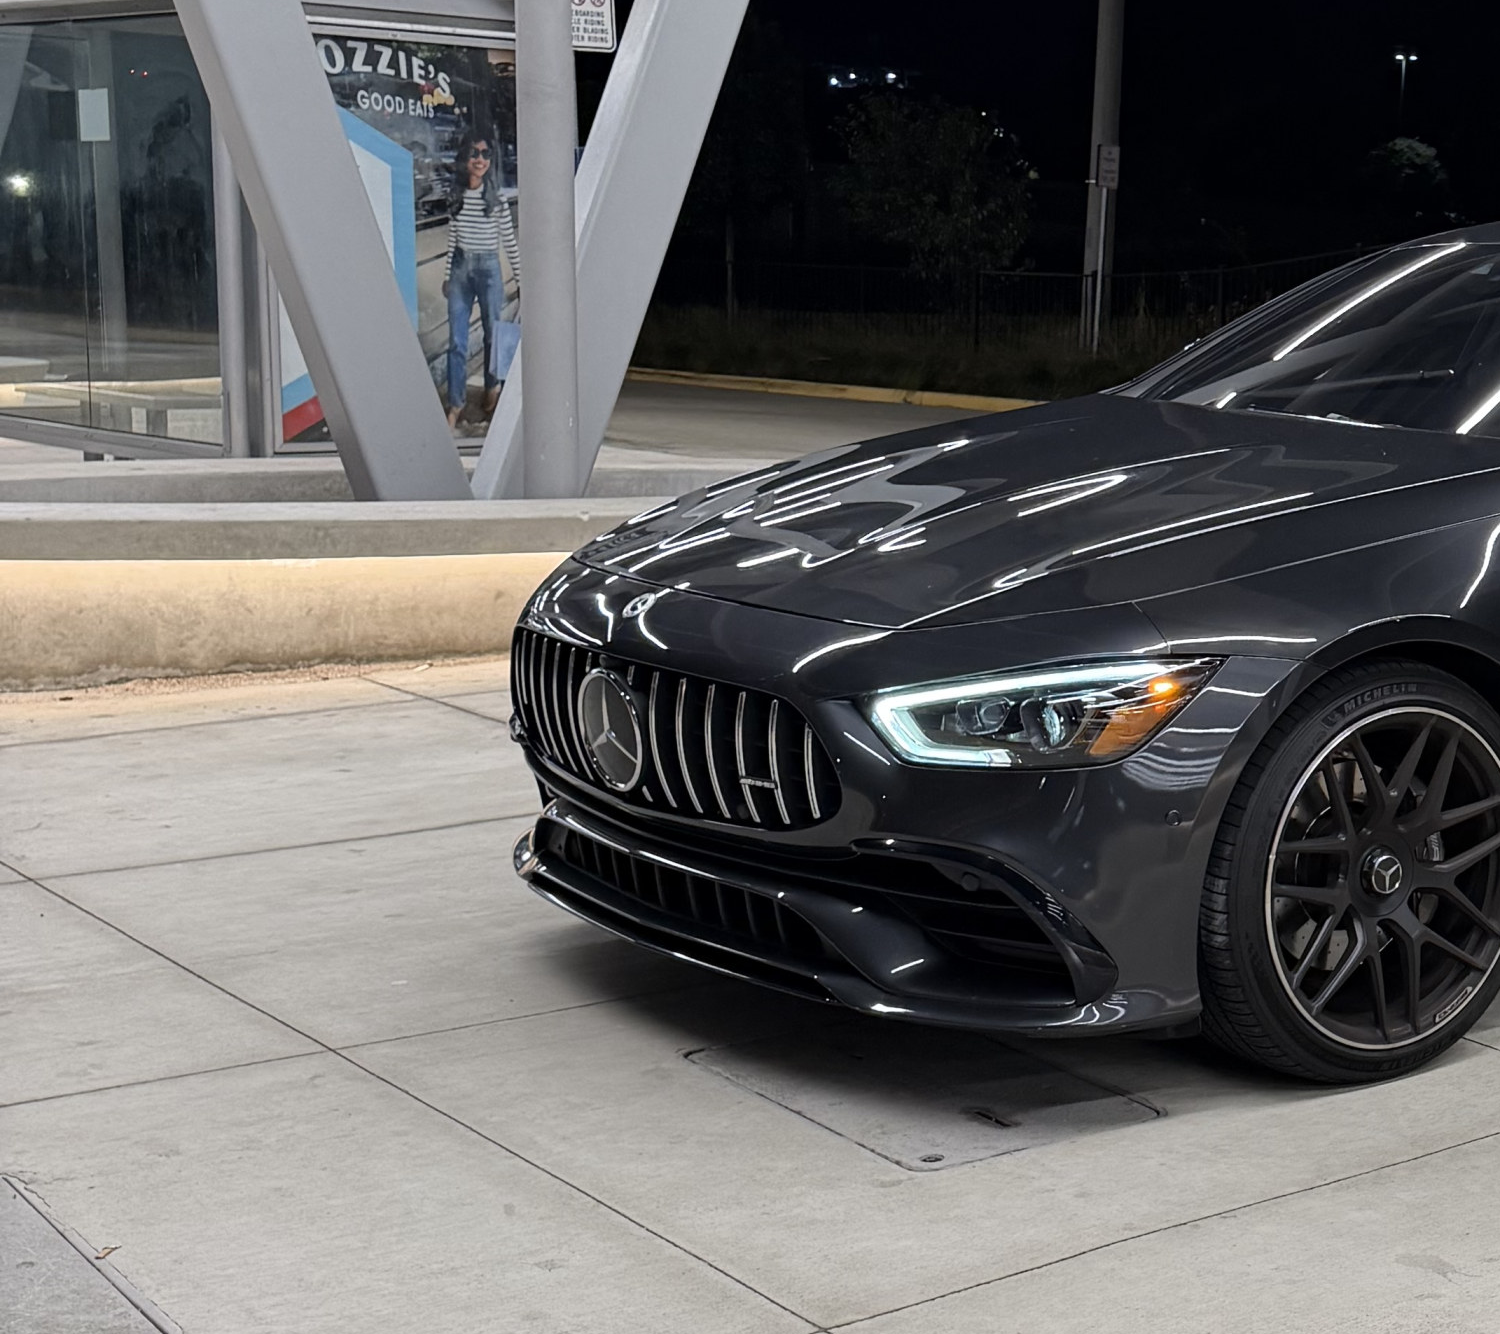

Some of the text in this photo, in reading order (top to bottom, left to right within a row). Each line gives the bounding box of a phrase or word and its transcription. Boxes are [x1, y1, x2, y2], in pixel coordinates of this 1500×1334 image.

[572, 9, 604, 18] BOARDING
[317, 38, 451, 99] OZZIE'S
[356, 89, 435, 118] GOOD EATS
[1343, 683, 1418, 714] MICHELIN
